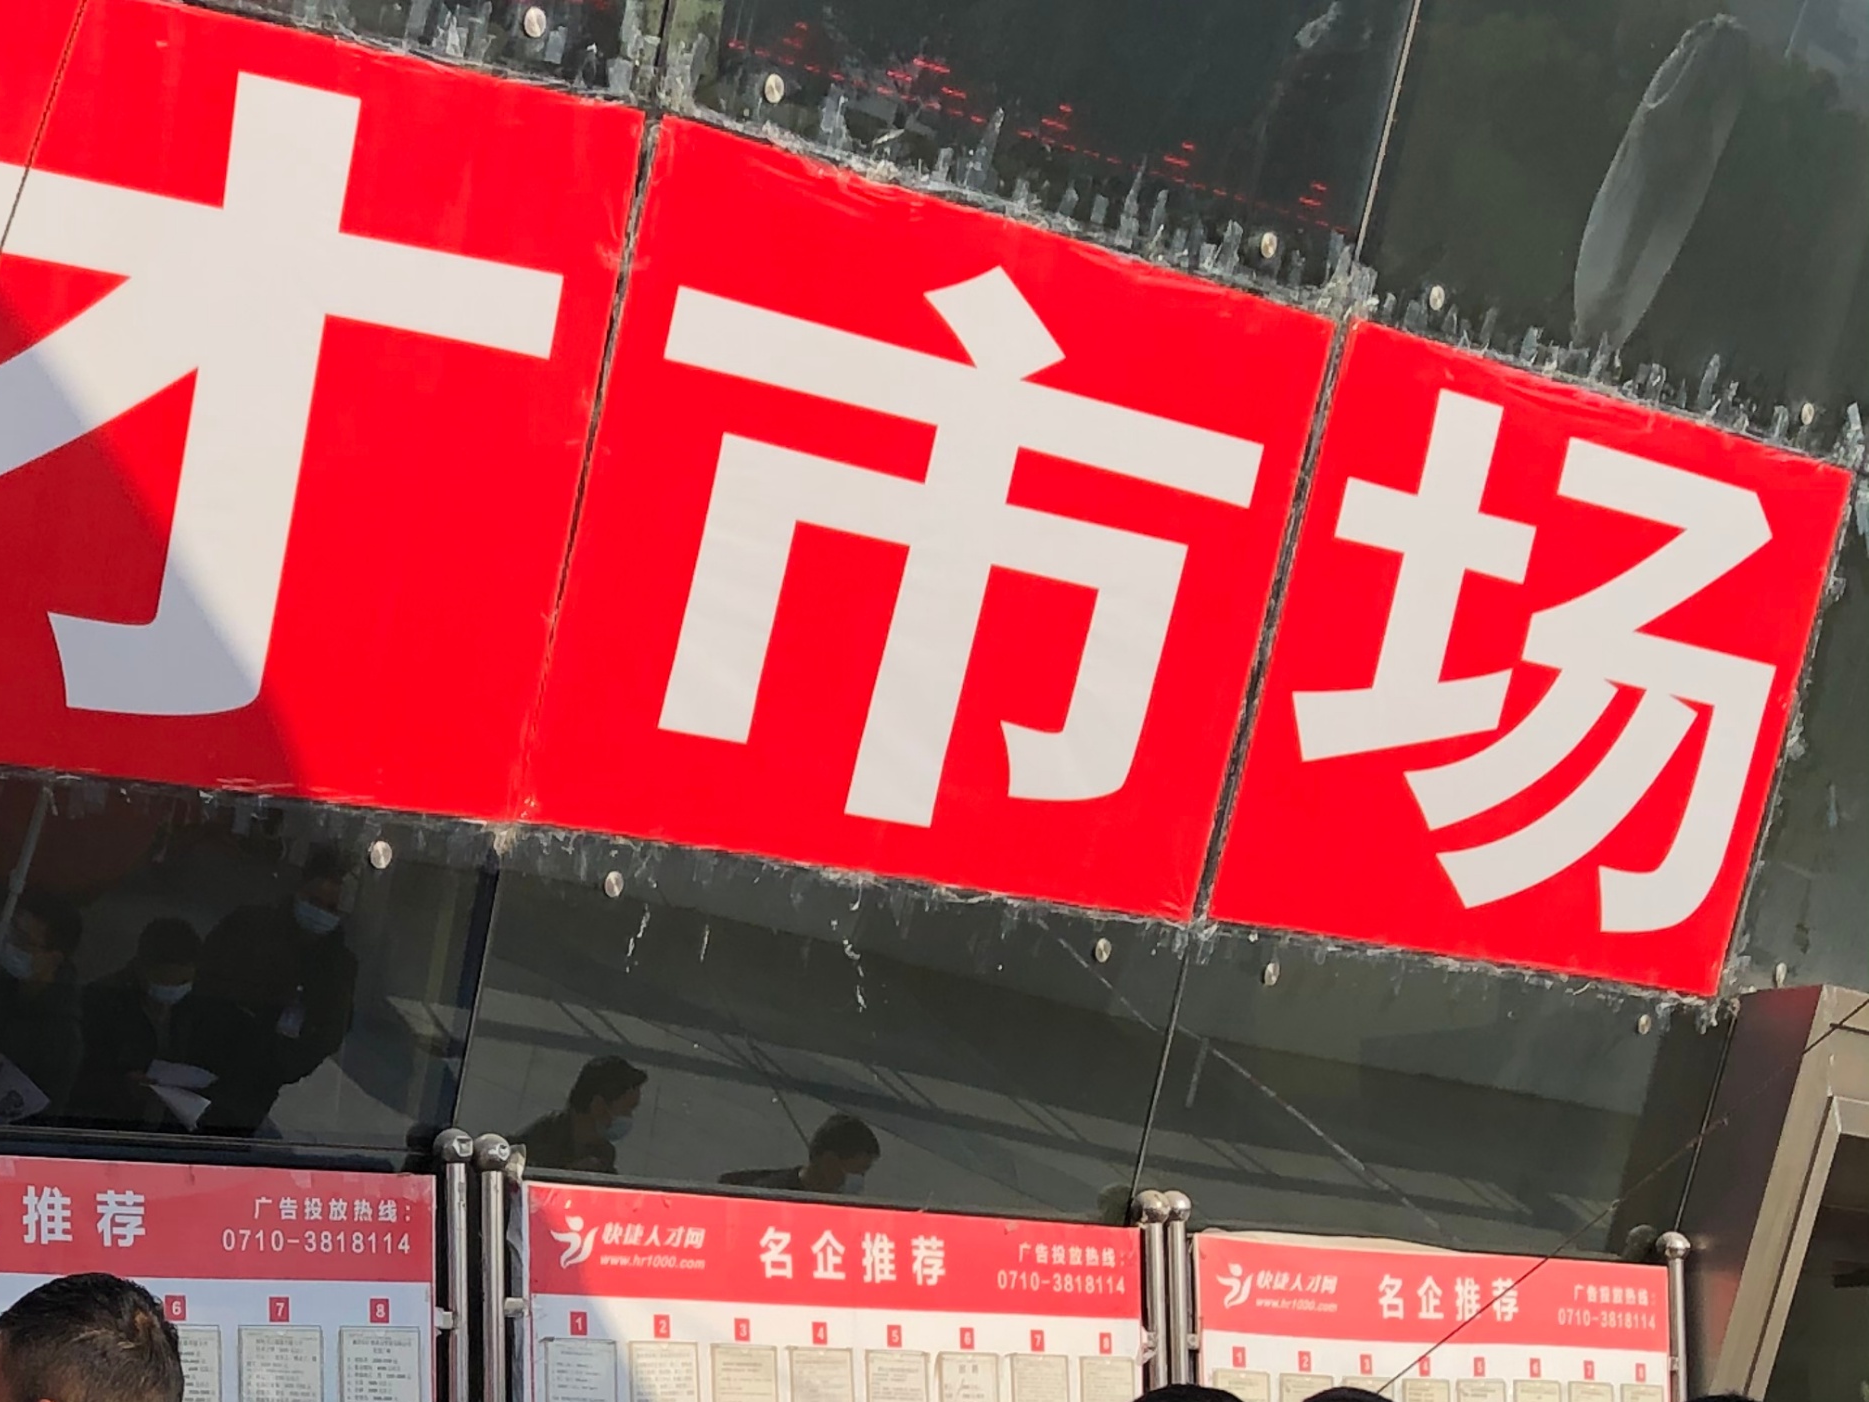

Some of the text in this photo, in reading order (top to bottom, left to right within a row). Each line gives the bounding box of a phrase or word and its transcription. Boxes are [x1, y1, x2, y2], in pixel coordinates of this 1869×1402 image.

[222, 1228, 411, 1255] 0710-3818114
[601, 1221, 707, 1249] 快捷人才网
[600, 1253, 707, 1270] www.hr1000.com
[758, 1225, 946, 1287] 名企推荐
[997, 1268, 1126, 1295] 0710-3818114
[1378, 1273, 1520, 1323] 名企推荐
[172, 1301, 182, 1316] 6
[275, 1303, 285, 1317] 7
[375, 1304, 386, 1318] 8
[575, 1317, 583, 1331] 1
[659, 1319, 668, 1334] 2
[1557, 1307, 1657, 1331] 0710-3818114
[739, 1323, 748, 1337] 3
[817, 1327, 825, 1340] 4
[891, 1329, 900, 1343] 5
[964, 1331, 972, 1345] 6
[1034, 1334, 1042, 1348] 7
